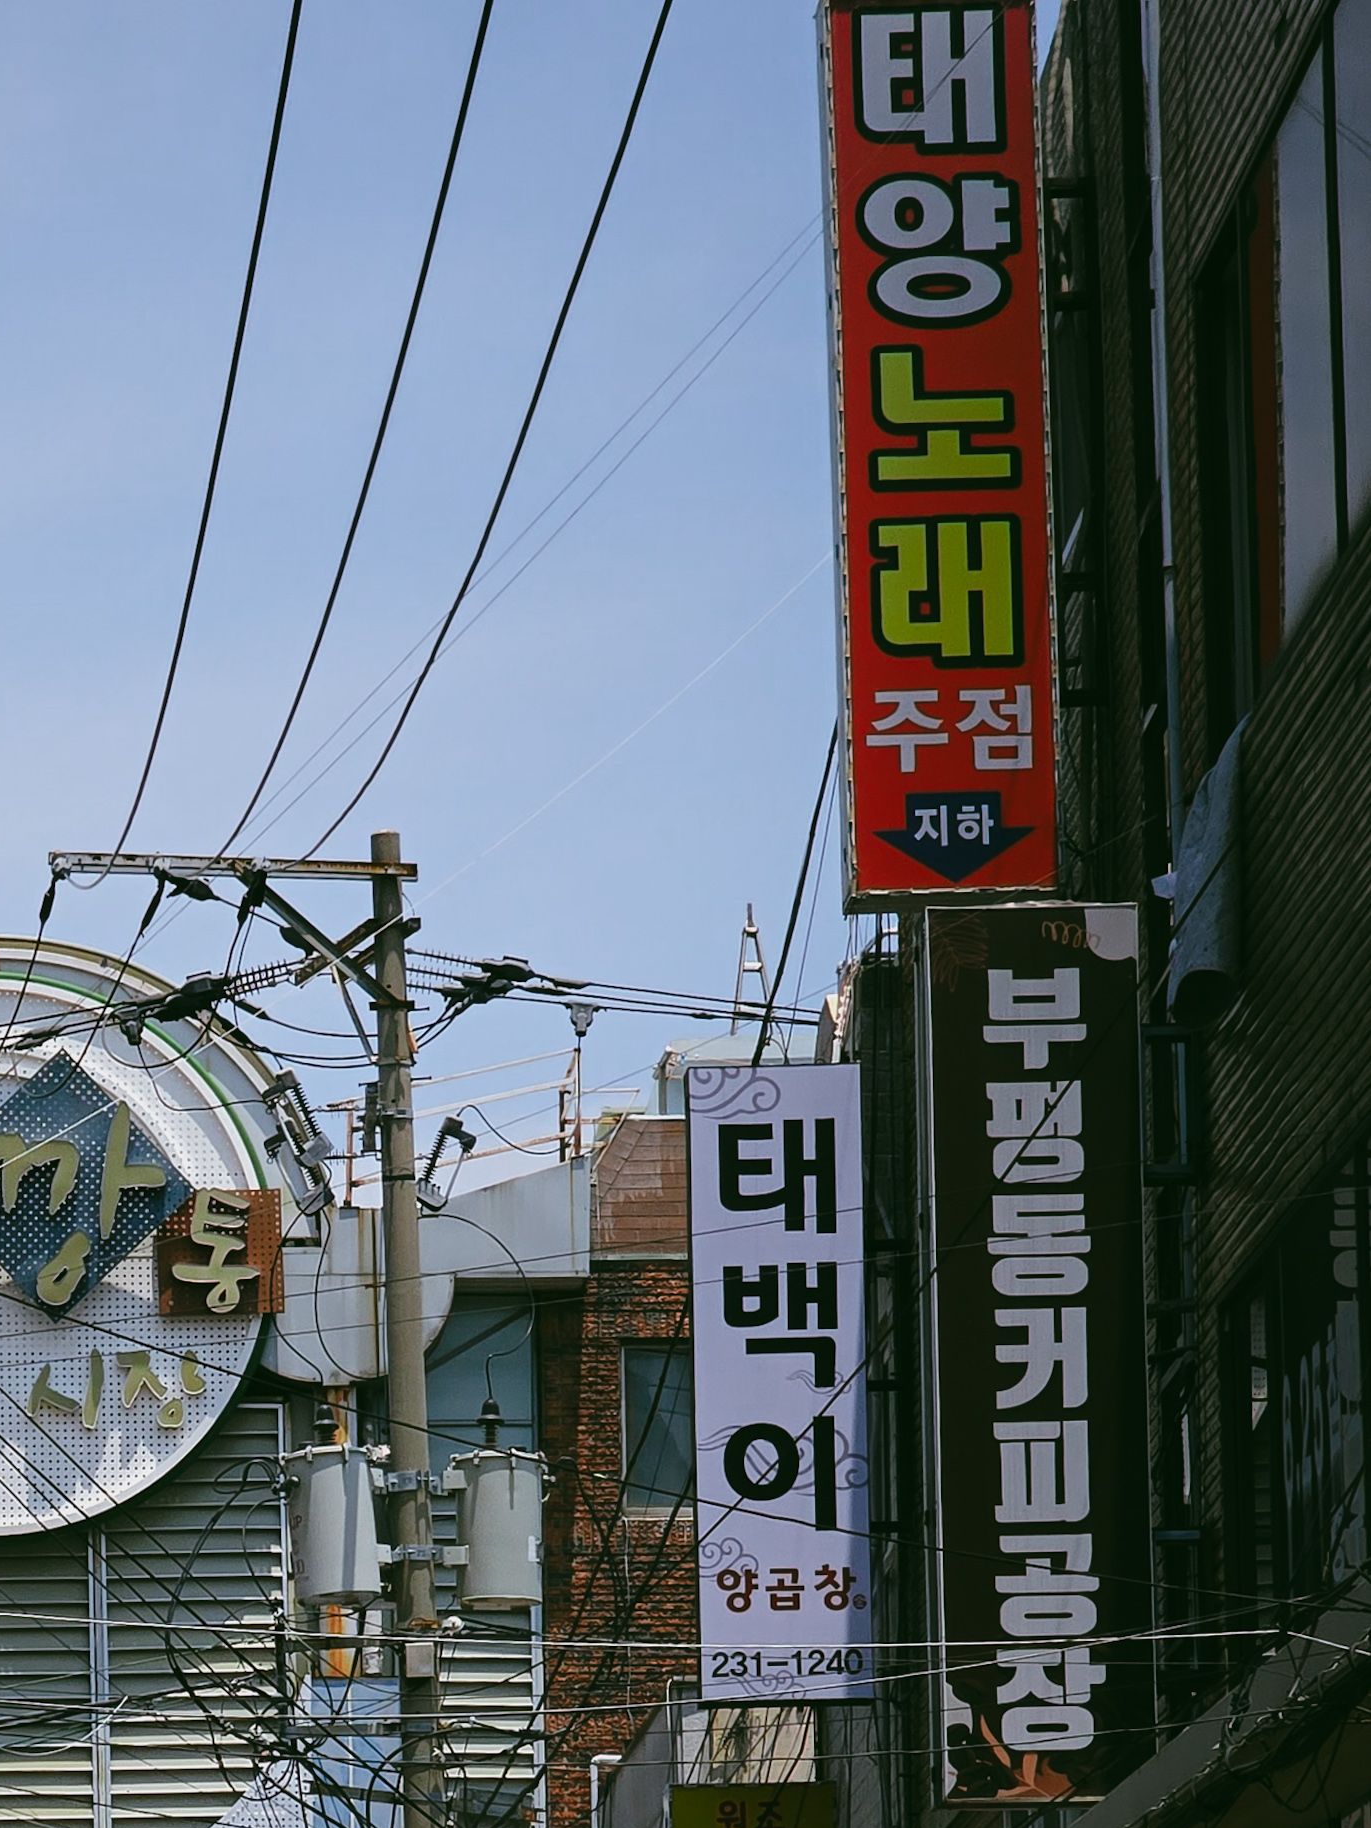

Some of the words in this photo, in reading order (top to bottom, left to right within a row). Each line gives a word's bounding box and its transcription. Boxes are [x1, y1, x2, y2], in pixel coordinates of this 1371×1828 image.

[855, 8, 1016, 325] 태양
[872, 344, 1024, 664] 노래
[865, 684, 1033, 772] 주점
[913, 803, 995, 846] 지하
[716, 1116, 840, 1533] 태백이
[29, 1348, 207, 1430] 시장
[716, 1564, 859, 1613] 양곱창
[710, 1646, 865, 1680] 231-1240
